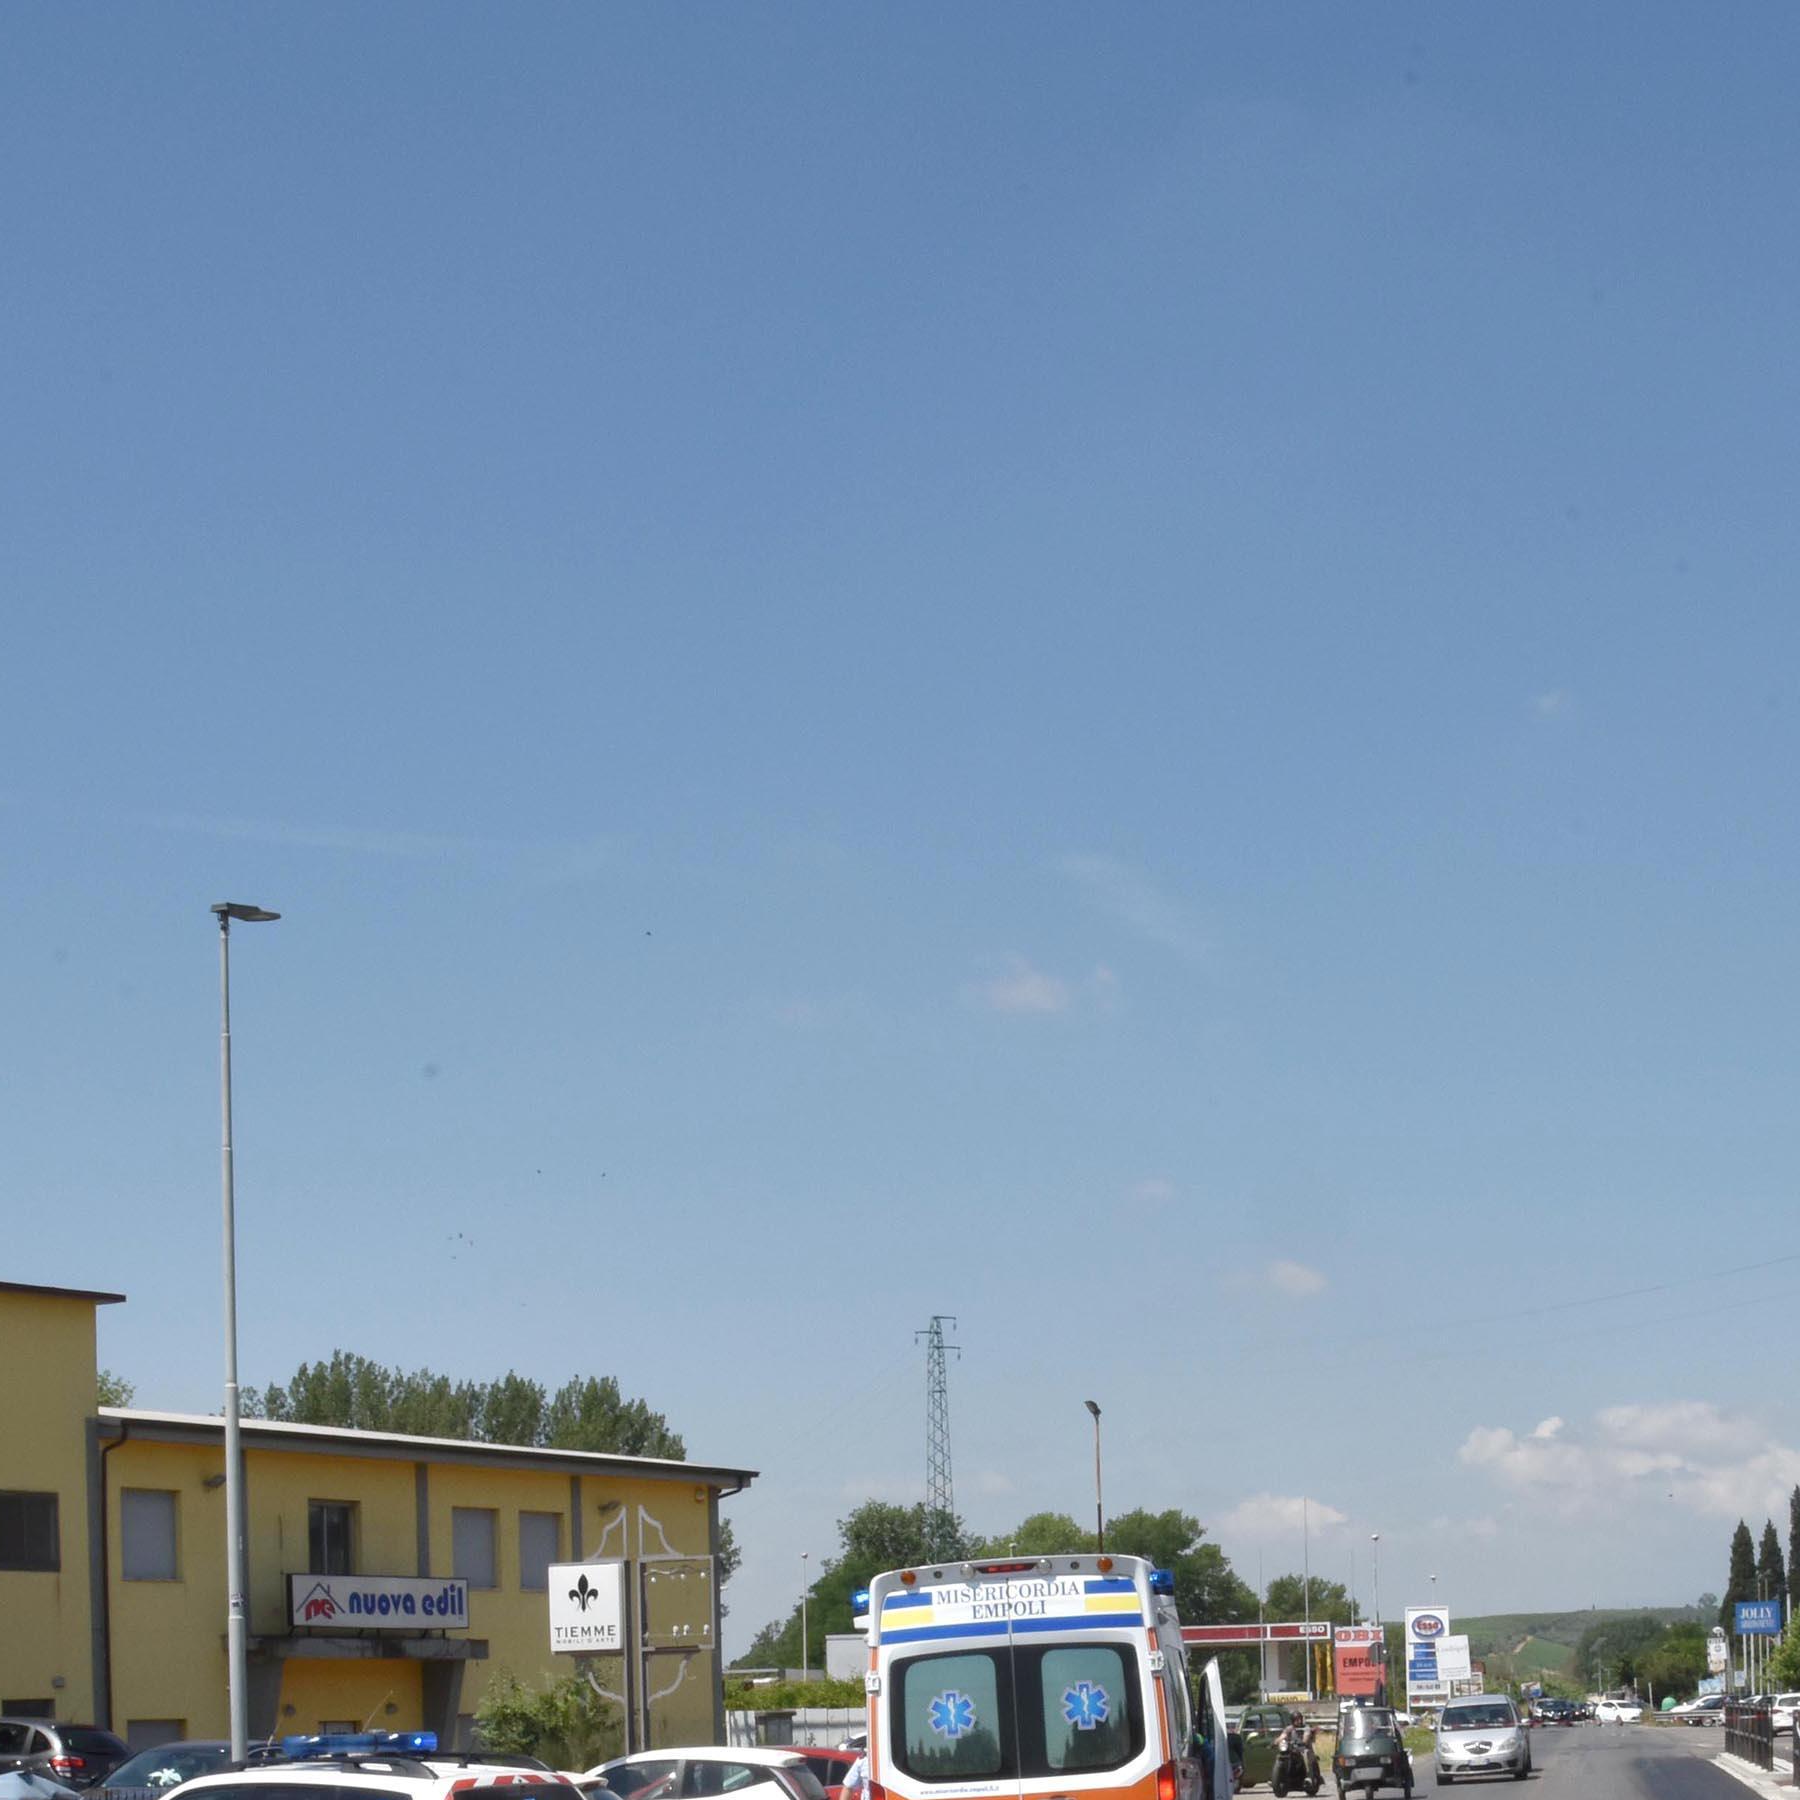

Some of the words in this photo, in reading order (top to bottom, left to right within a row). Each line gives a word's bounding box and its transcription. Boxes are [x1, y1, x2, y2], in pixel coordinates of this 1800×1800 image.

[937, 1580, 1080, 1605] MISERICORDIA
[349, 1591, 416, 1616] nuova
[422, 1583, 464, 1616] edil
[972, 1600, 1047, 1620] EMPOLI
[1741, 1607, 1774, 1619] JOLLY
[555, 1624, 616, 1638] TIEMME
[1299, 1625, 1325, 1634] ESSO
[1335, 1629, 1383, 1642] OBI
[1343, 1657, 1378, 1668] EMPOL
